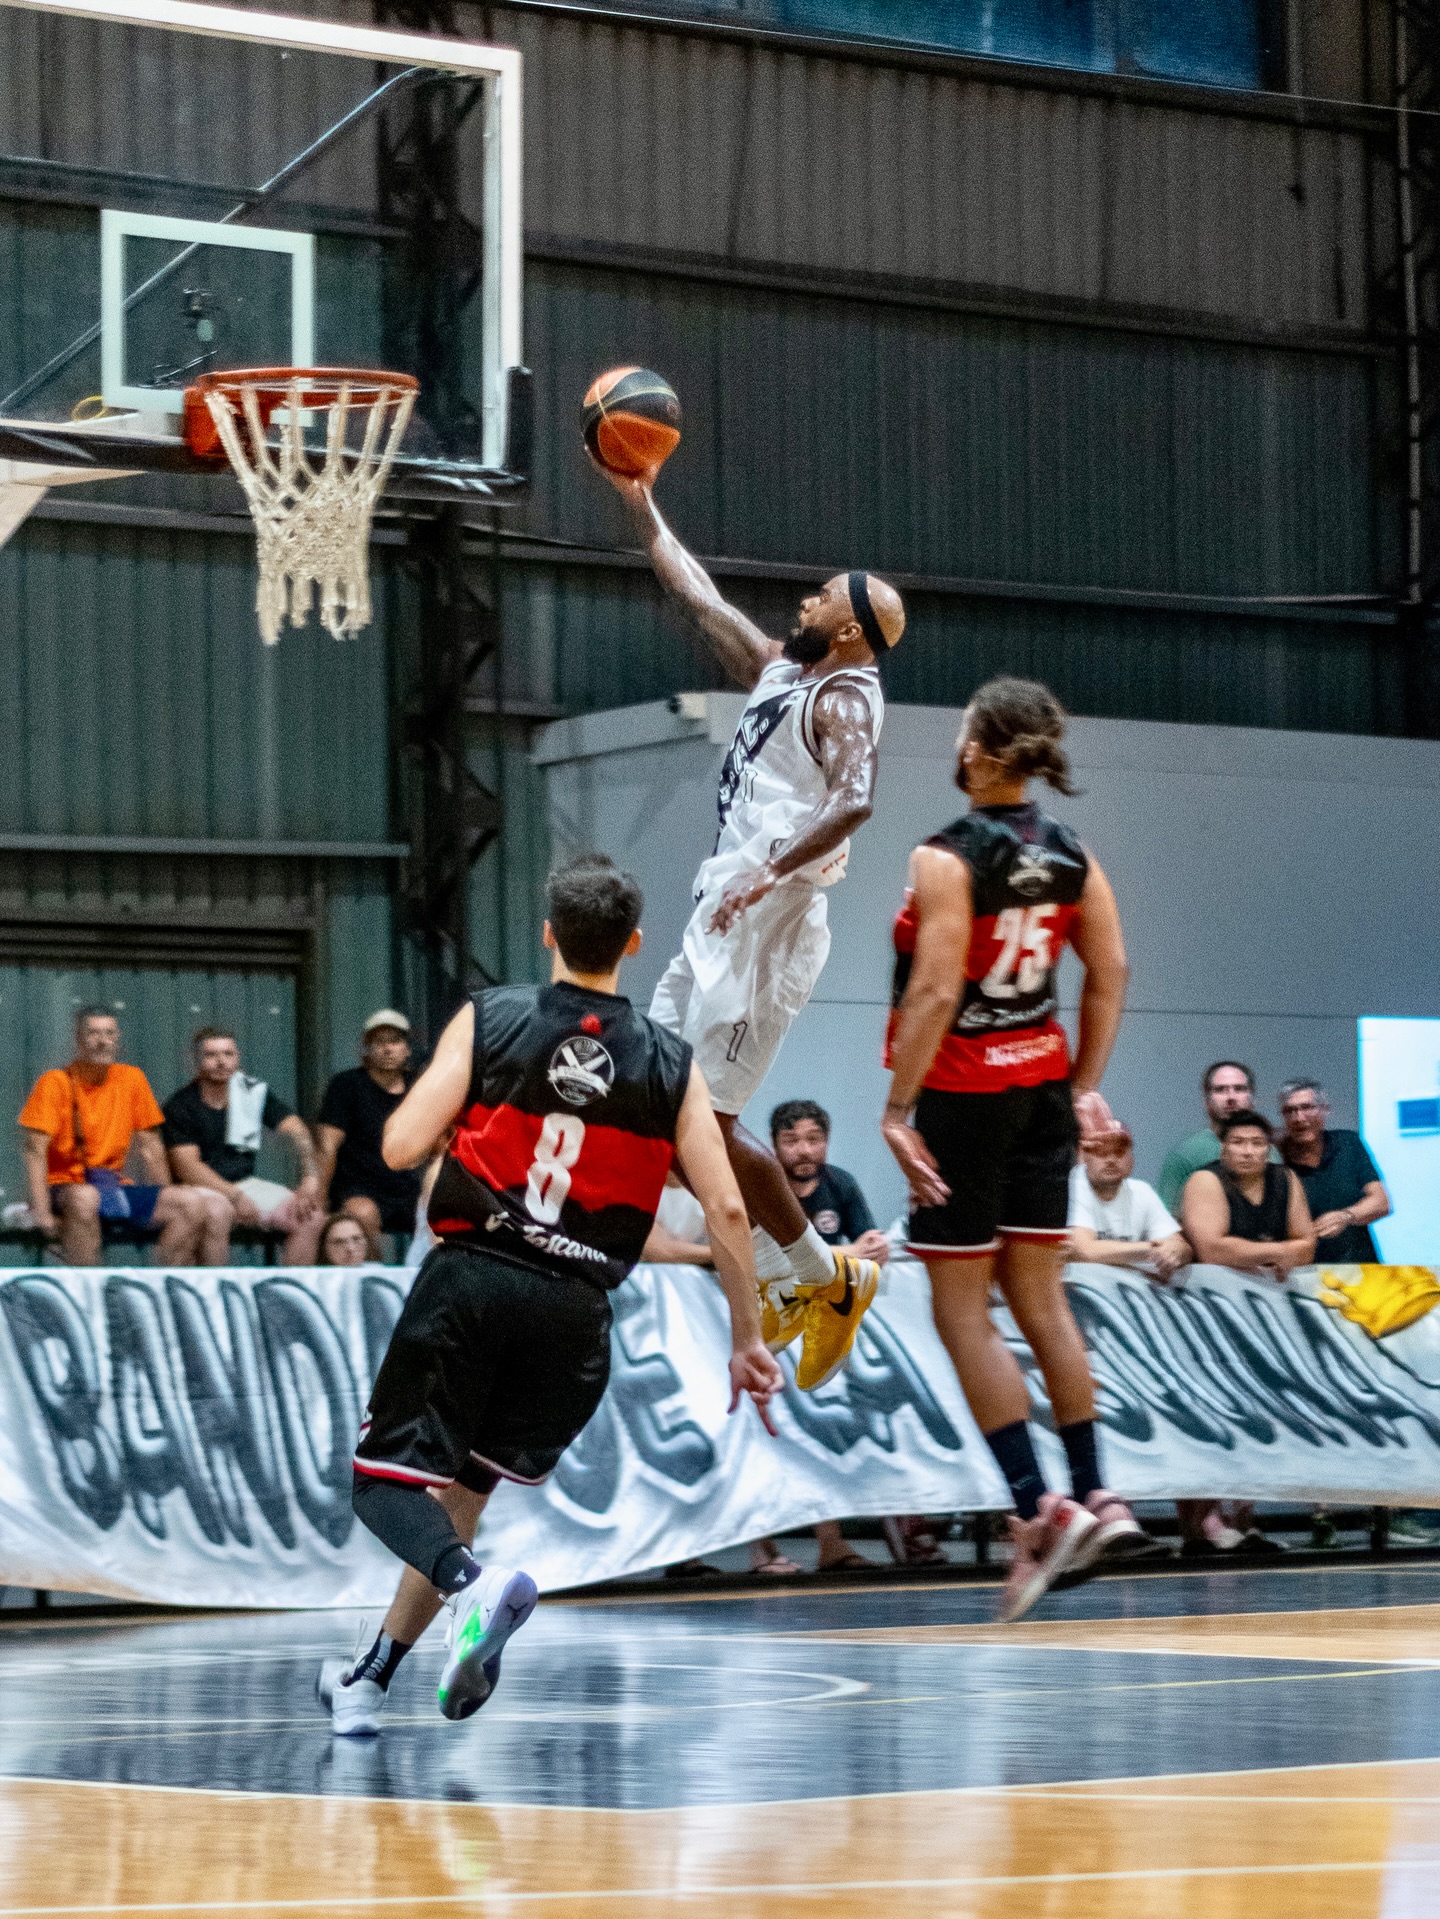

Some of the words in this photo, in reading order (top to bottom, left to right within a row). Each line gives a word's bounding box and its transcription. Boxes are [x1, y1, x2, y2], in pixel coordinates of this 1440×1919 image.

[743, 769, 758, 803] 1
[980, 903, 1059, 998] 25
[726, 1020, 748, 1062] 1
[525, 1112, 586, 1226] 8
